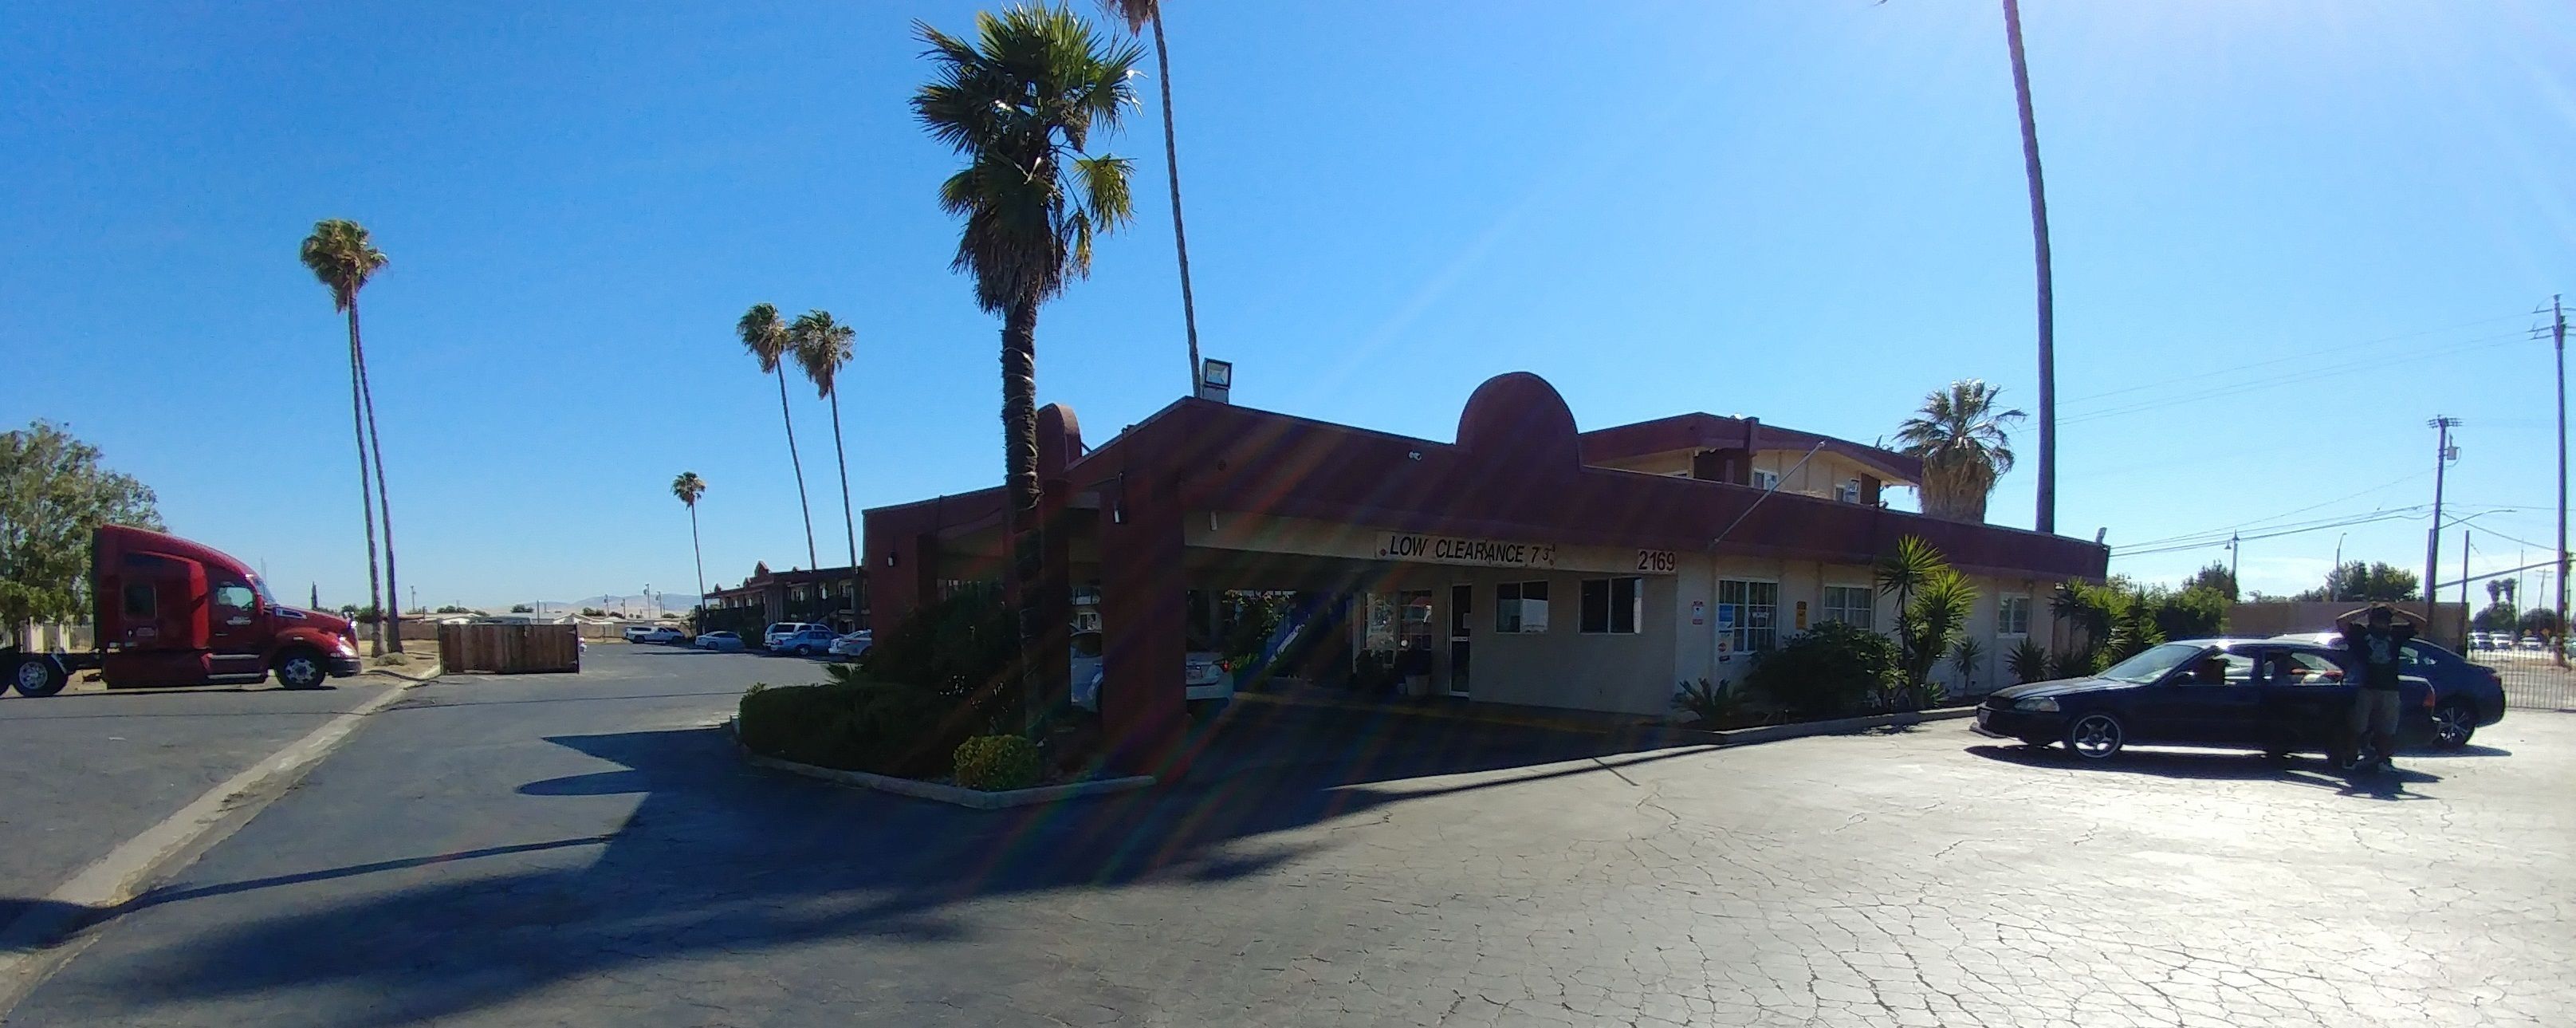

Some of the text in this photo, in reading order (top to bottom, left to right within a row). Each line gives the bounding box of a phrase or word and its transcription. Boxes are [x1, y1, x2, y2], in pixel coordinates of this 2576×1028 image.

[1390, 535, 1429, 557] LOW
[1436, 538, 1524, 562] CLEARANCE
[1638, 550, 1675, 571] 2169
